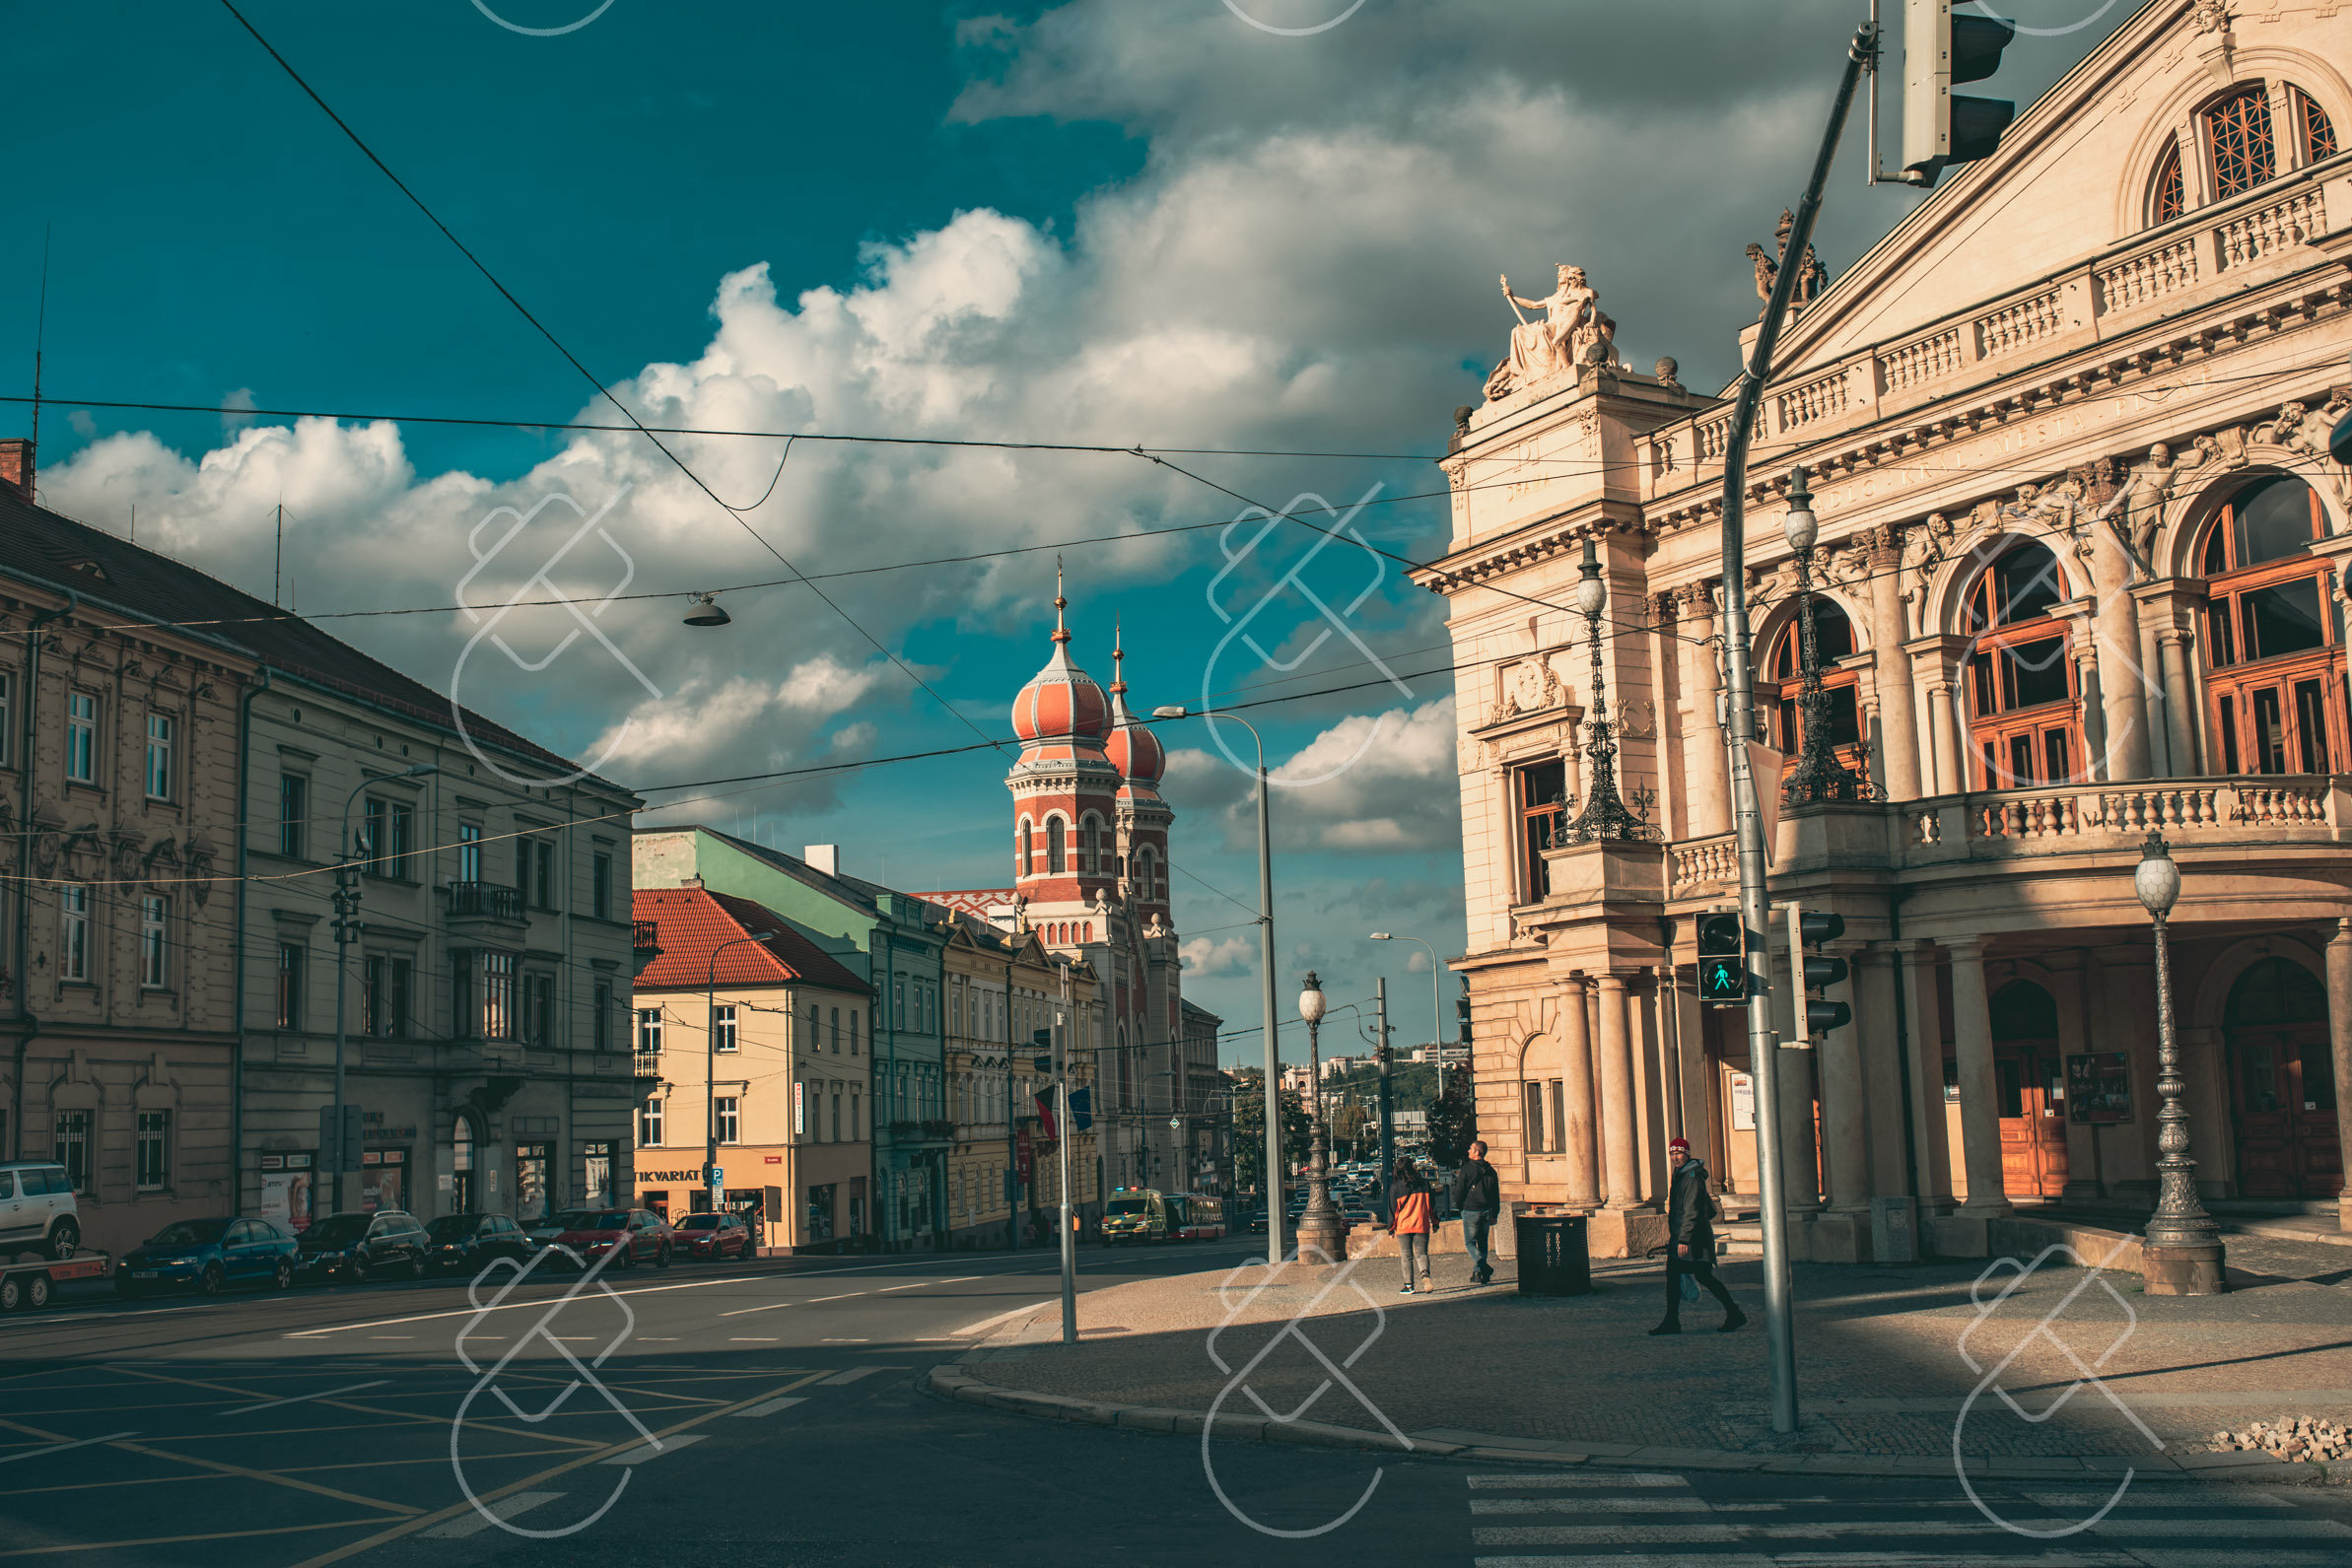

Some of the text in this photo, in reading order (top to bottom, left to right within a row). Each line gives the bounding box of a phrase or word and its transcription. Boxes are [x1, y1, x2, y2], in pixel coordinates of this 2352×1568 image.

[1771, 480, 1876, 527] DADLO
[1993, 413, 2087, 457] MĚSTA
[714, 1170, 721, 1181] P
